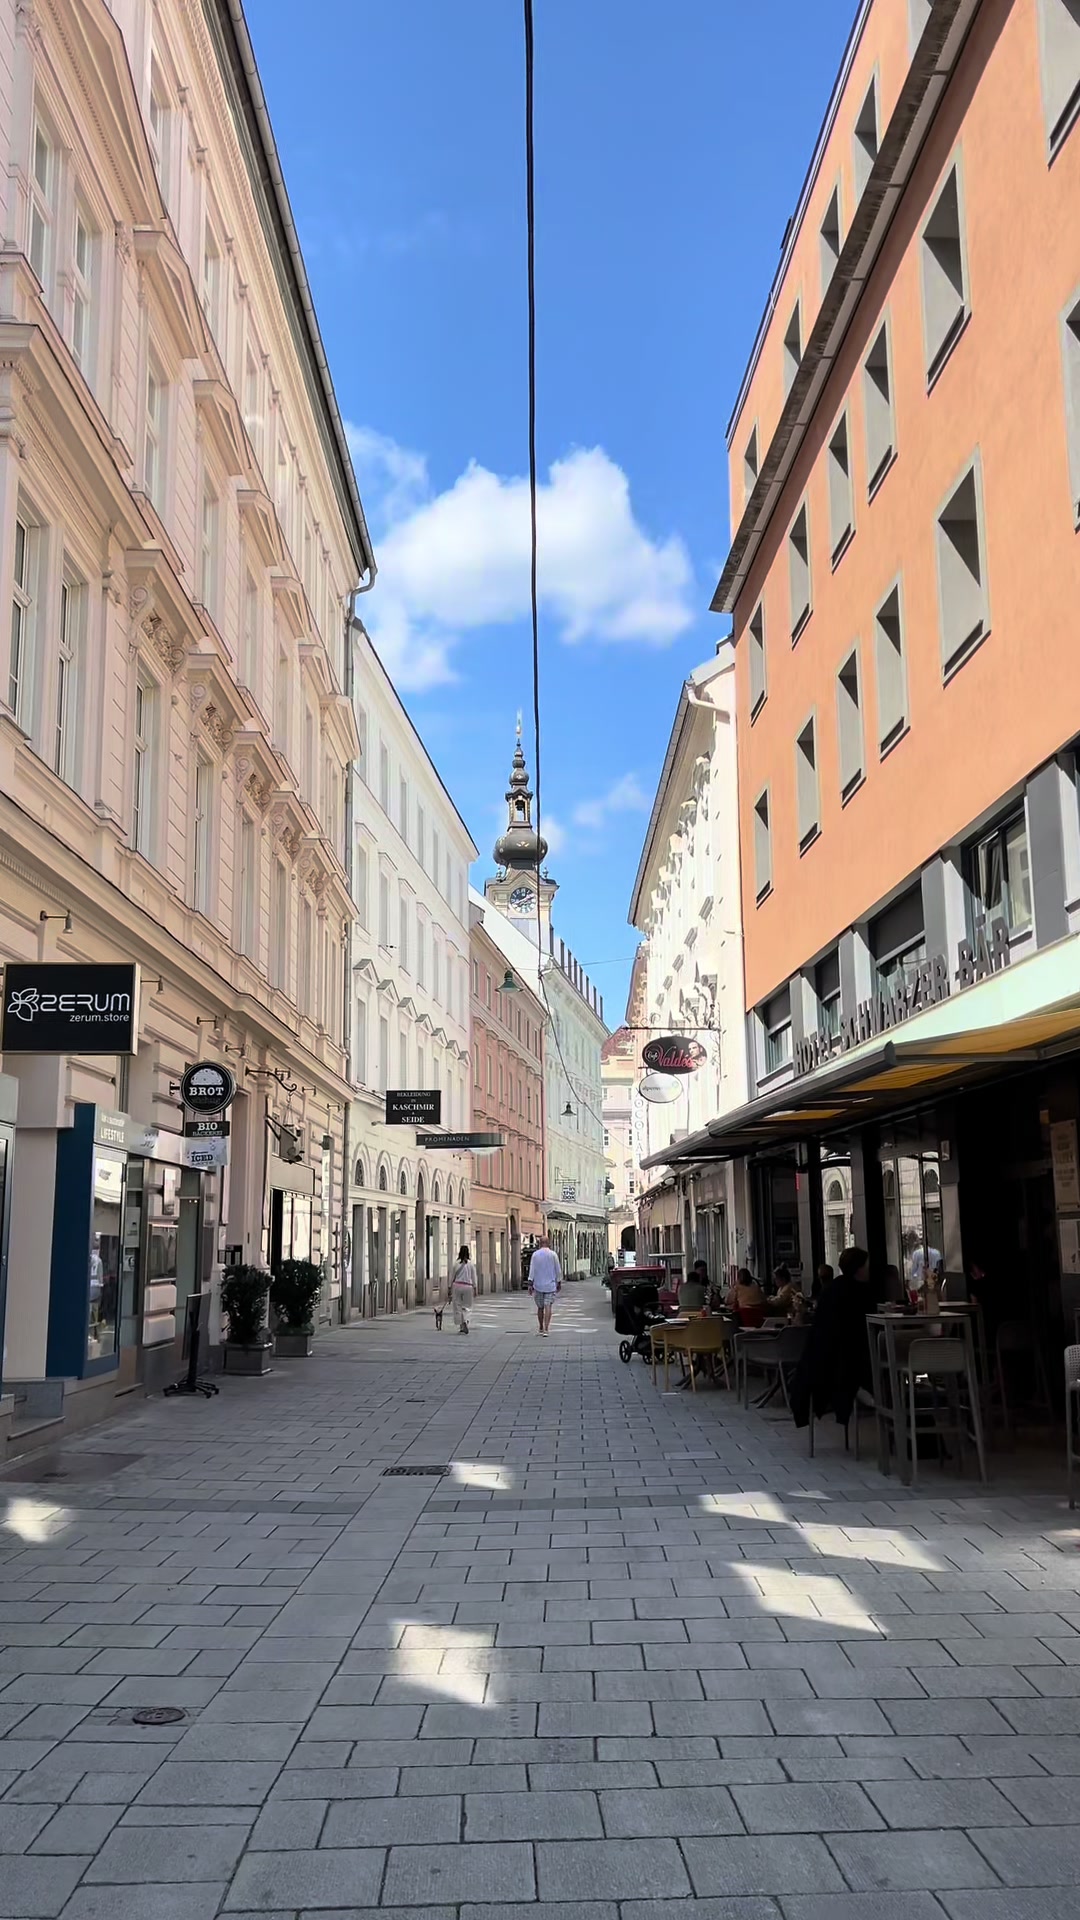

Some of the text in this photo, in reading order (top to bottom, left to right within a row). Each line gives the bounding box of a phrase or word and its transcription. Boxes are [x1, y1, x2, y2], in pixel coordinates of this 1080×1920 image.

[793, 914, 1011, 1075] HOTEL SCHWARZER BÄR
[40, 994, 130, 1011] ZERUM
[69, 1013, 130, 1022] zerum.store
[189, 1087, 224, 1096] BROT
[197, 1122, 218, 1131] BIO
[101, 1127, 124, 1143] LIFESTYLE
[191, 1154, 213, 1162] ICED
